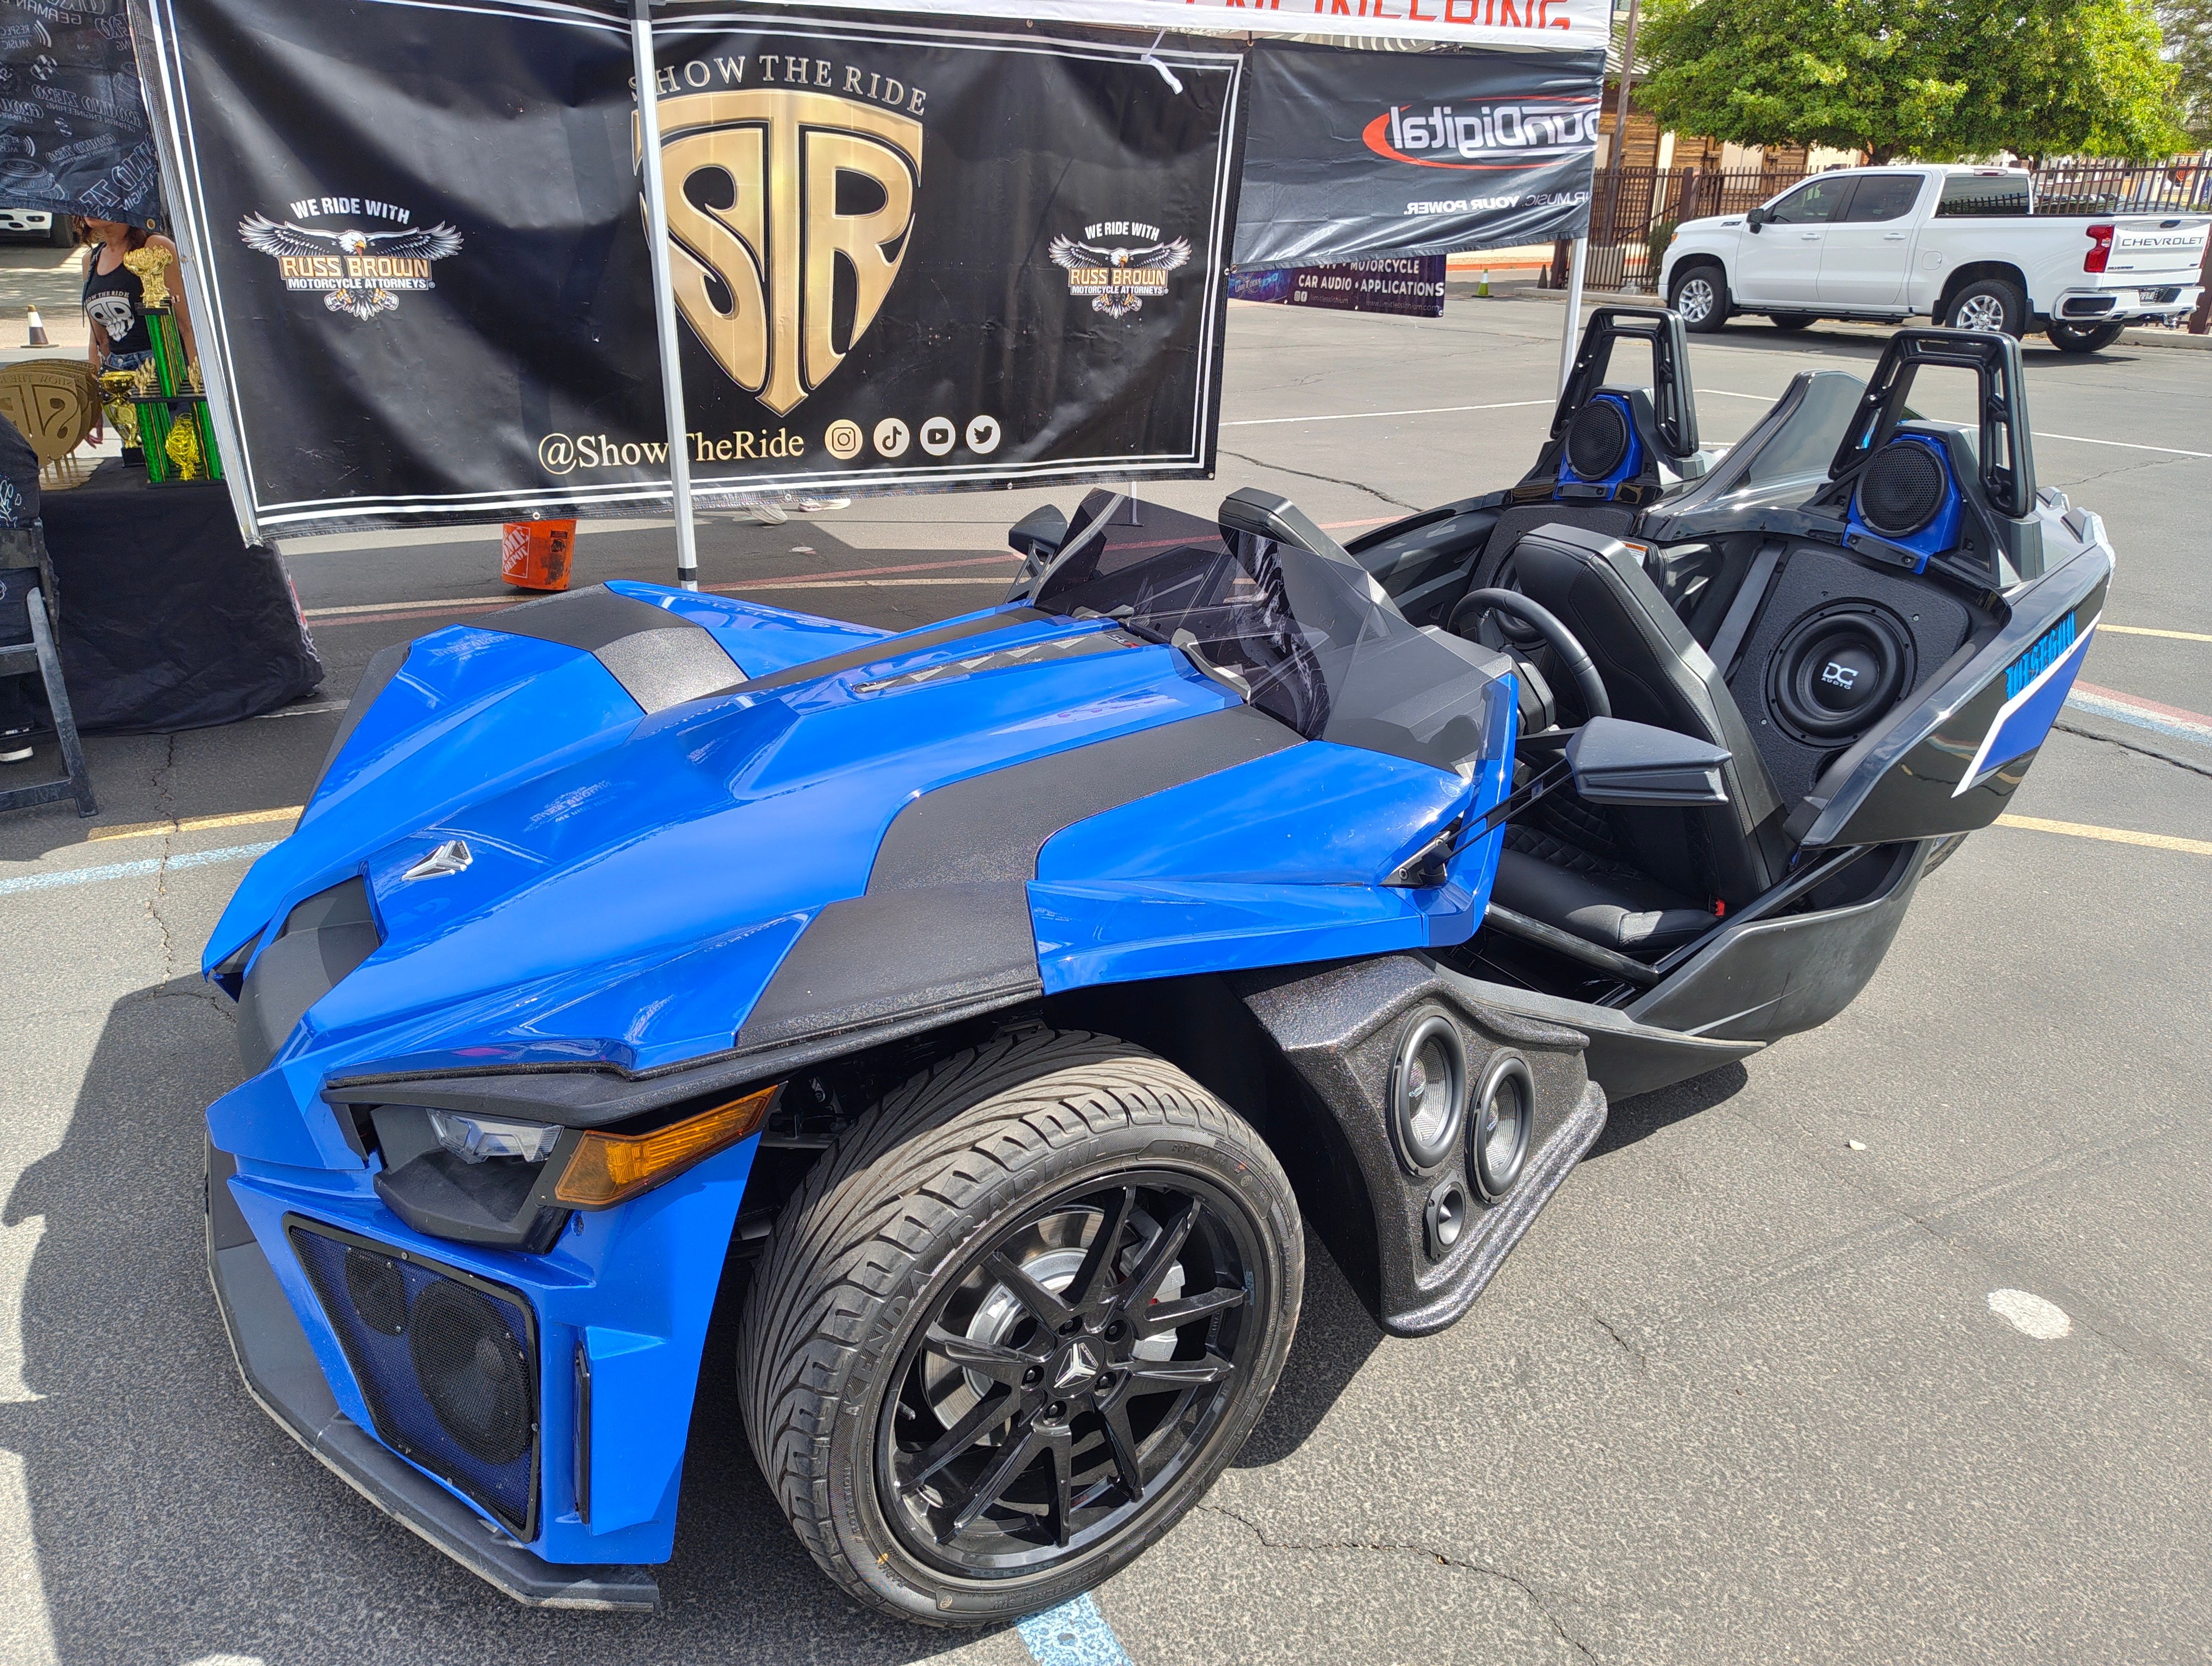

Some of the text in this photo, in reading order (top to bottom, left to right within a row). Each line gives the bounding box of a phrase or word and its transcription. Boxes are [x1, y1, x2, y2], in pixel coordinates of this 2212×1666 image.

[759, 54, 832, 88] THE
[843, 65, 928, 116] RIDE
[290, 197, 411, 225] WE RIDE WITH
[1084, 221, 1160, 241] WE RIDE WITH
[2121, 236, 2205, 247] CHEVROLET
[280, 255, 430, 279] RUSS BROWN
[1070, 268, 1167, 286] RUSS BROWN
[288, 278, 427, 290] MOTORCYCLE ATTORNEYS
[1071, 286, 1119, 294] MOTORCYCLE
[1298, 274, 1444, 297] CAR AUDIO APPLICATIONS
[1821, 677, 1851, 690] AUDIO
[1822, 662, 1859, 686] DC
